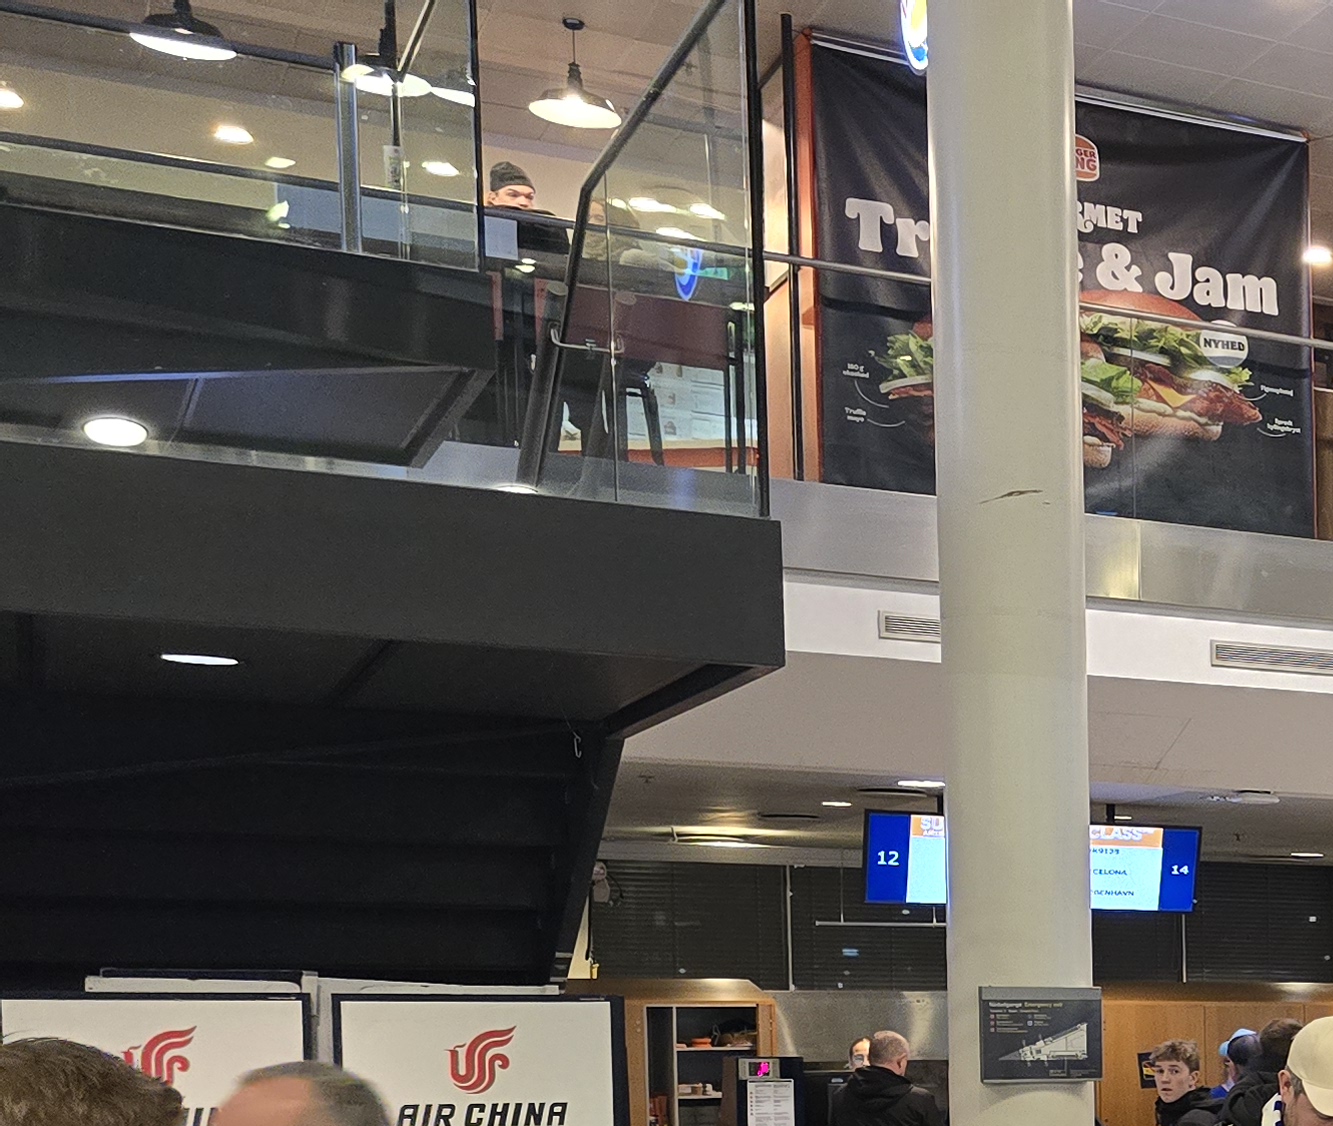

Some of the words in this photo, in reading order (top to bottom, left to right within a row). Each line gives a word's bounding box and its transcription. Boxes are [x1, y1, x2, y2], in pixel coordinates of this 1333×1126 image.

[1155, 252, 1279, 316] Jam
[1204, 337, 1245, 351] NYHED
[877, 850, 900, 866] 12
[1093, 868, 1128, 876] CELONA
[1171, 864, 1190, 875] 14
